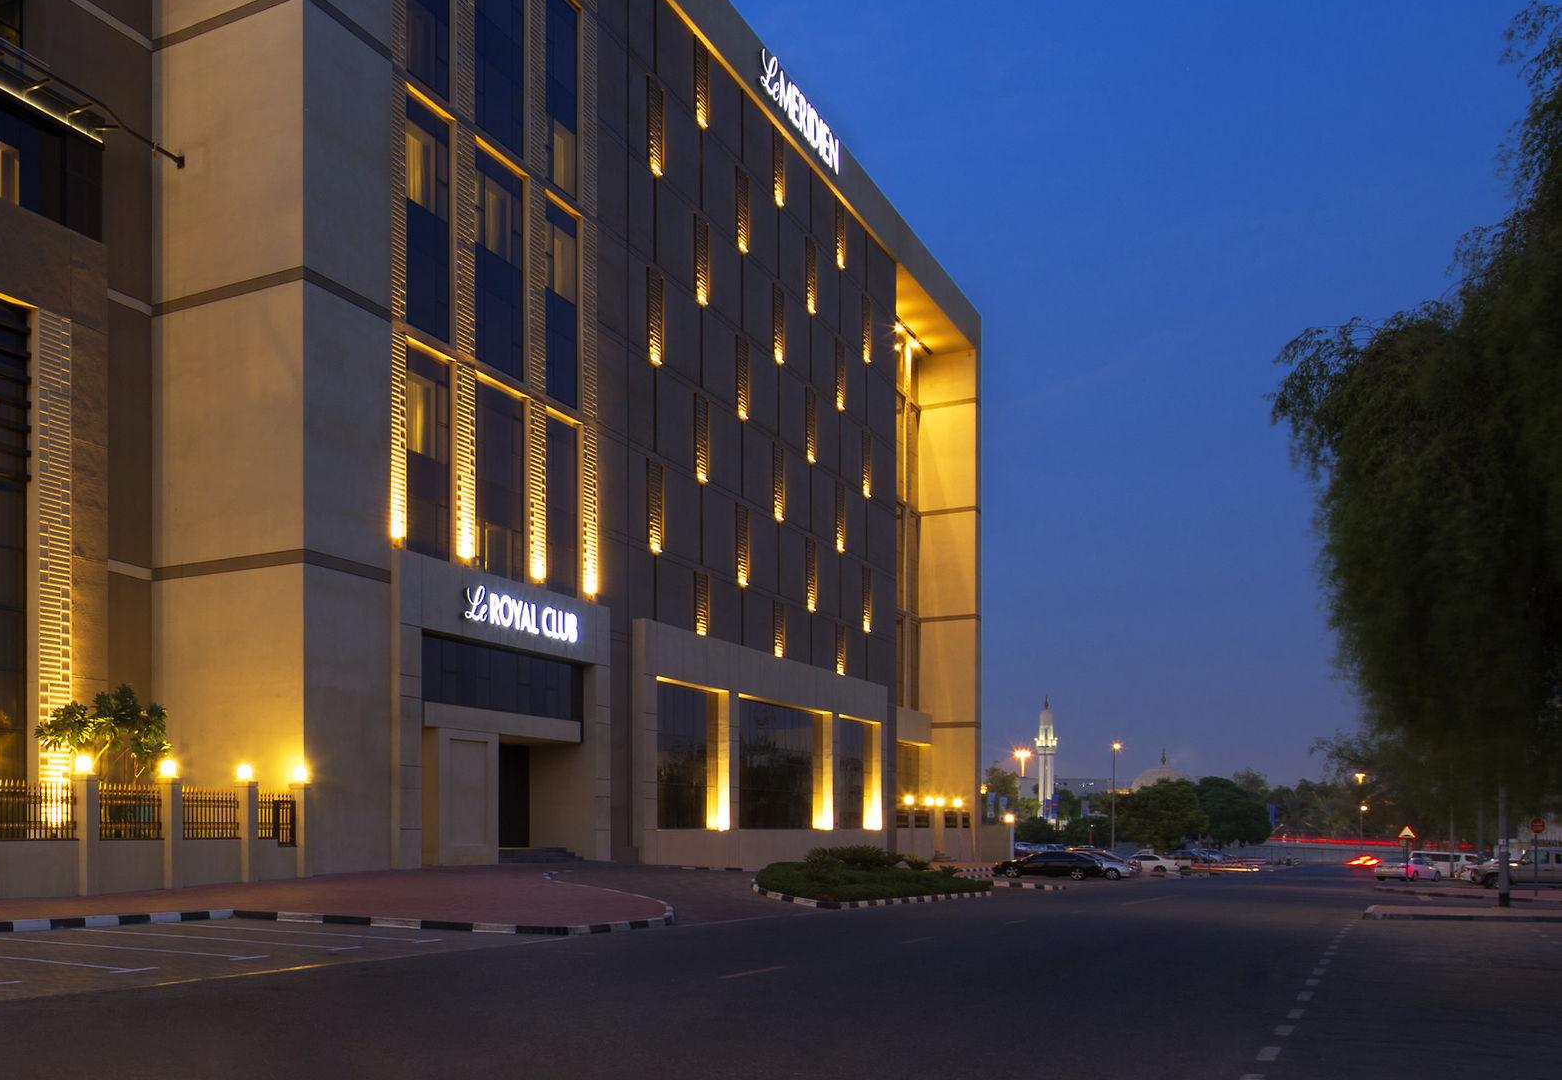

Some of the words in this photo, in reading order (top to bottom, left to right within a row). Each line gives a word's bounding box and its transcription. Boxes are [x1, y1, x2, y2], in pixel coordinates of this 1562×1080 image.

[760, 48, 780, 102] Le
[778, 70, 840, 175] MERIDIEN
[464, 585, 488, 622] Le
[489, 592, 540, 635] ROYAL
[541, 606, 578, 644] CLUB
